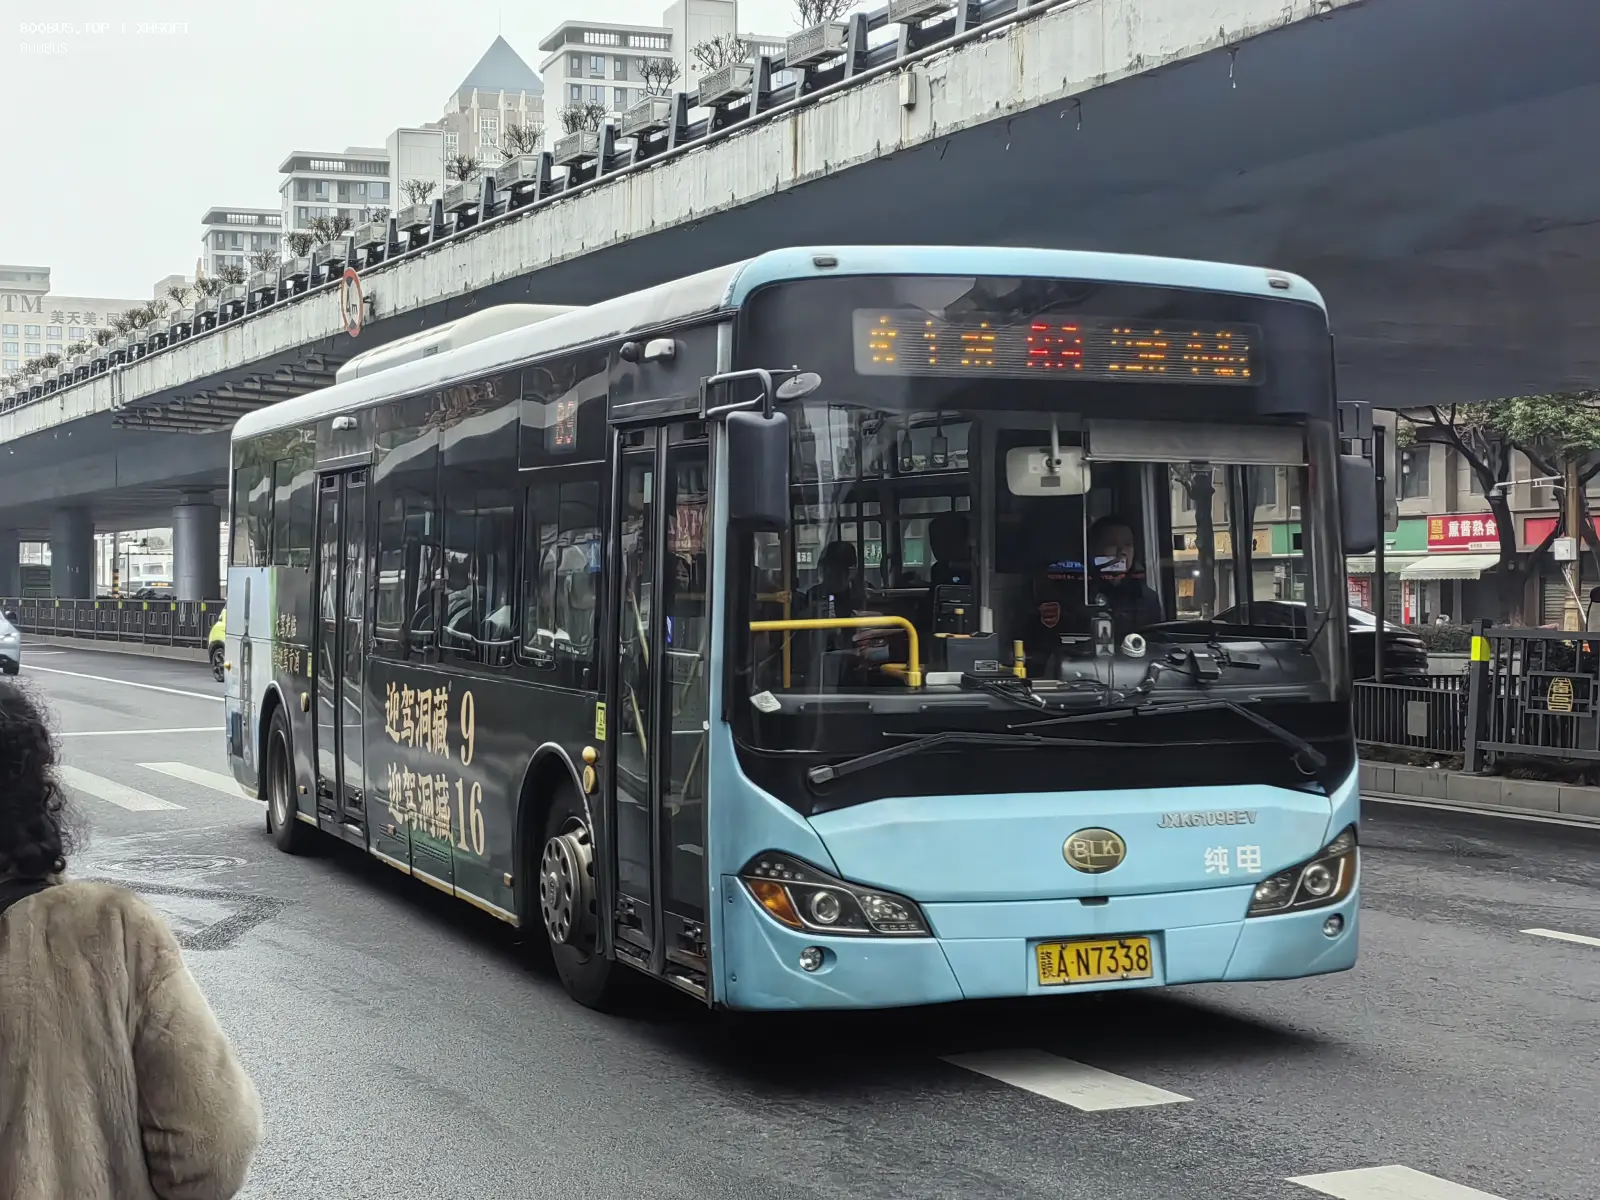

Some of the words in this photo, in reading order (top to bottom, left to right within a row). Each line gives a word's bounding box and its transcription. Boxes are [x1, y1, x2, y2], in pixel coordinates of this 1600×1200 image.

[461, 690, 475, 766] 9
[455, 777, 485, 856] 16
[1157, 809, 1258, 828] JXK6109BEV
[1073, 839, 1116, 859] BLK
[1204, 845, 1262, 875] 纯电
